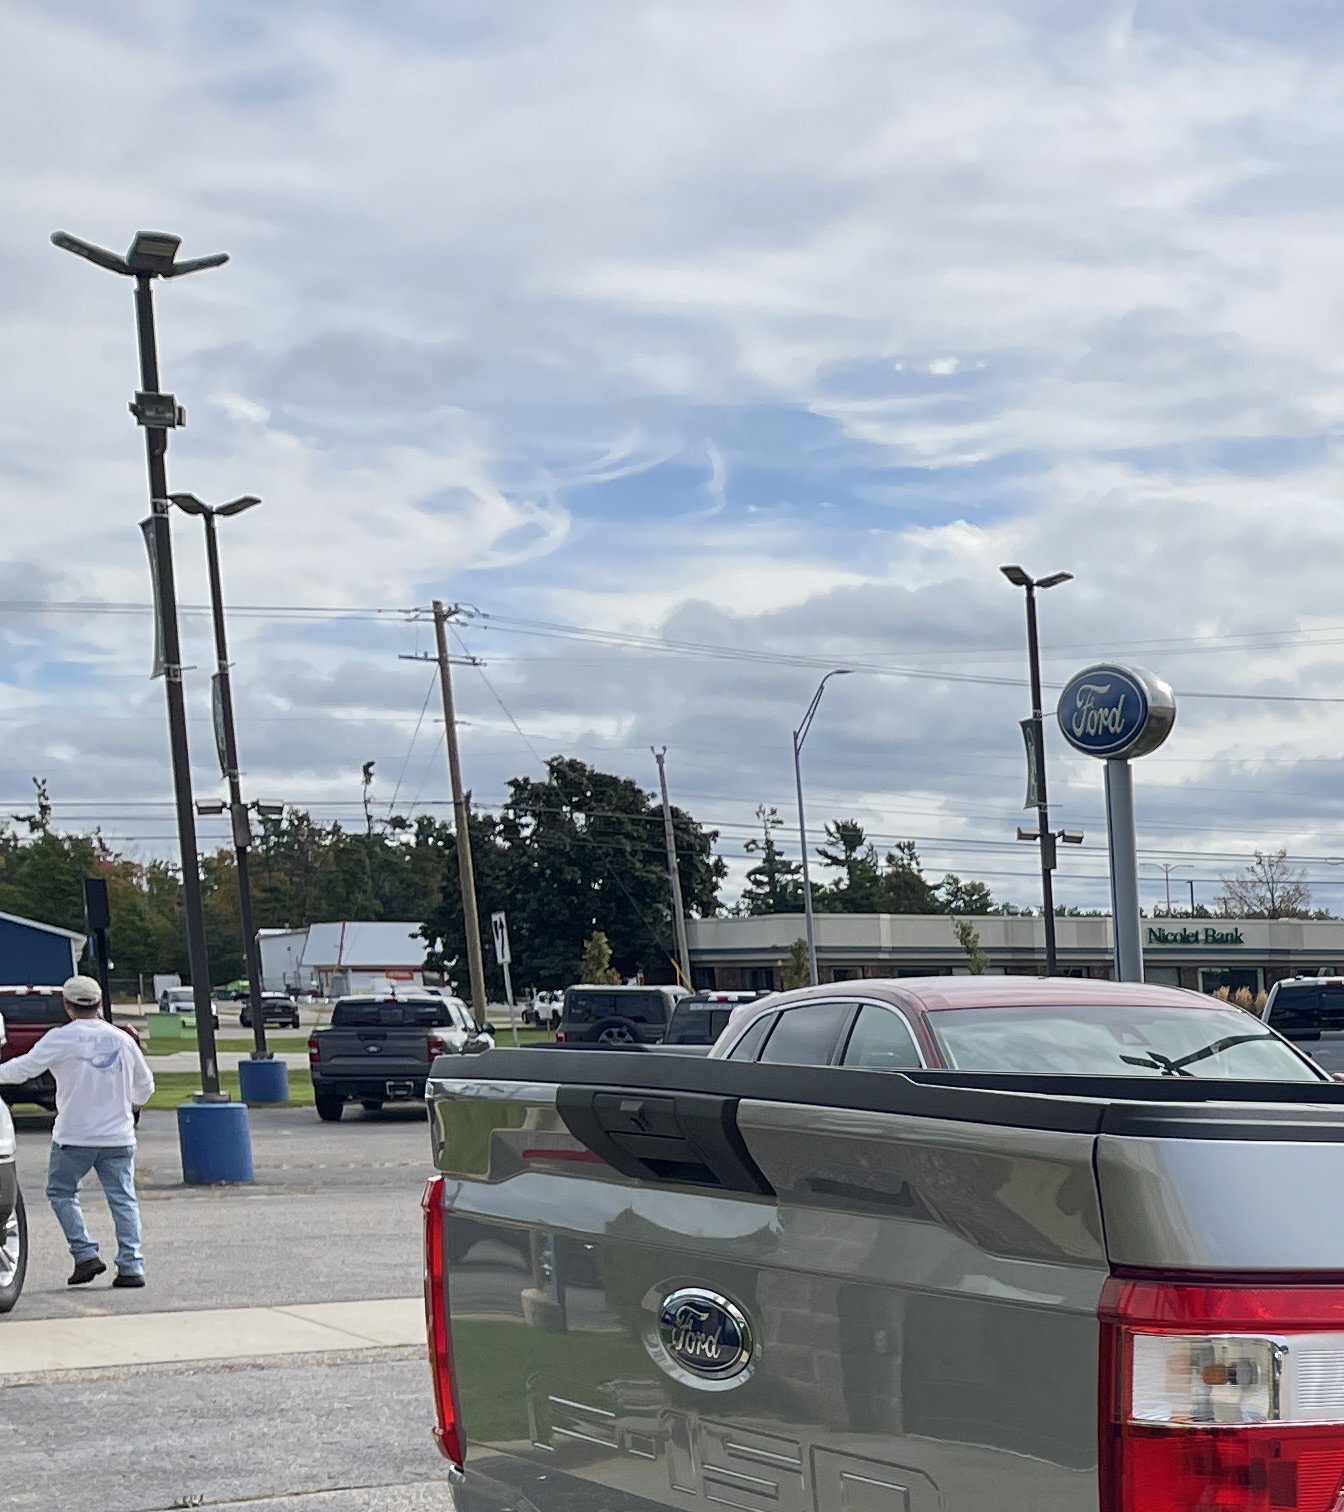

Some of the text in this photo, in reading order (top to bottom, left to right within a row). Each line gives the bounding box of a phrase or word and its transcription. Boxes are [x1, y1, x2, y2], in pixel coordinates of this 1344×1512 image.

[1072, 683, 1126, 738] Ford
[1147, 927, 1245, 944] Nicolet Bank
[671, 1305, 722, 1359] Ford
